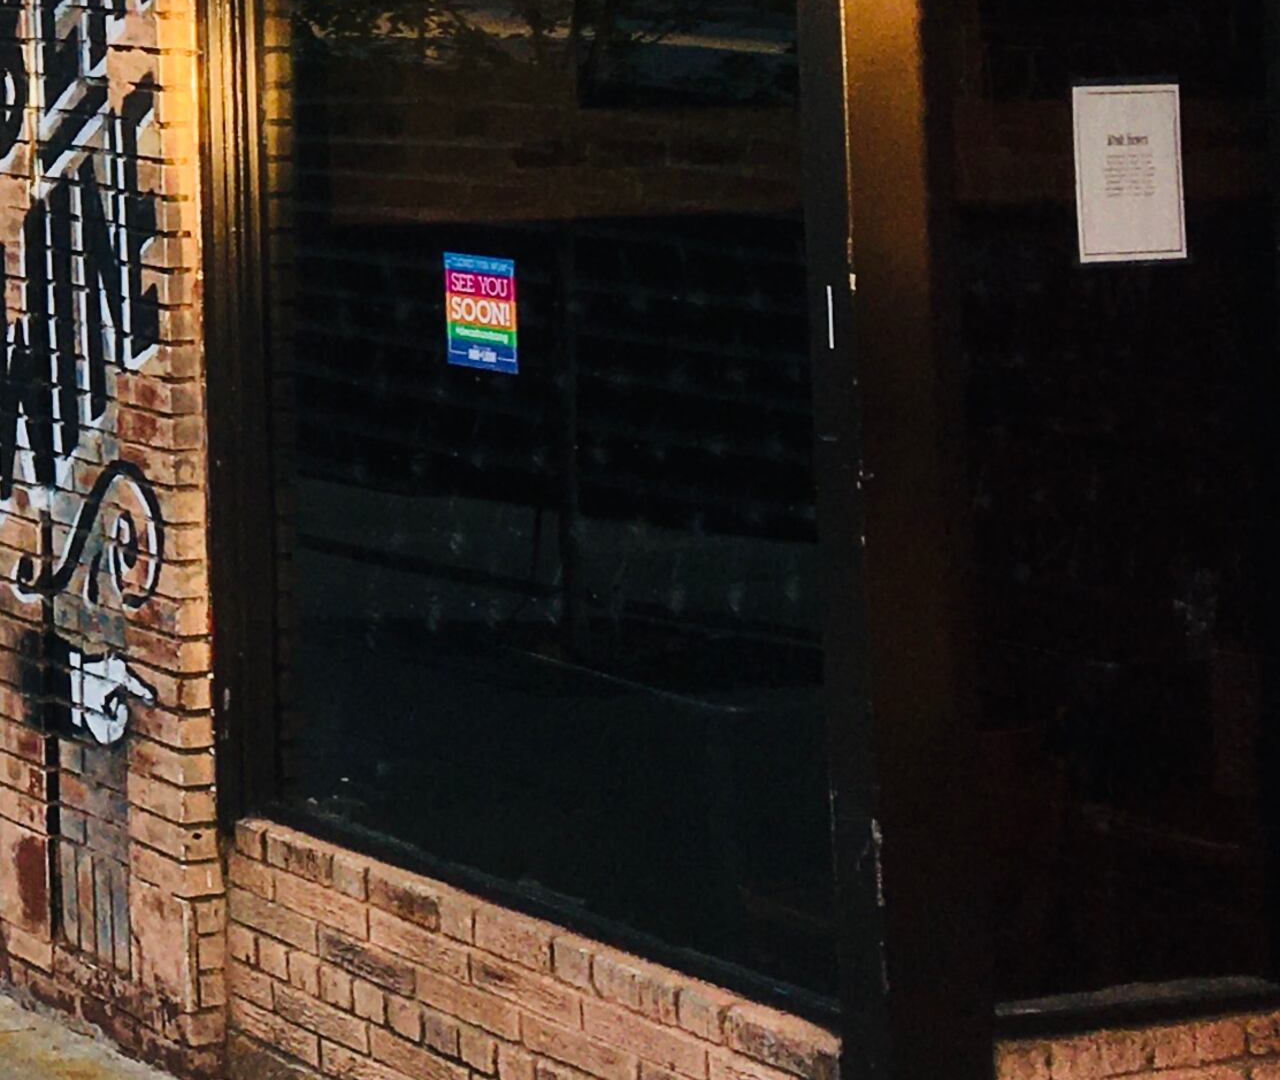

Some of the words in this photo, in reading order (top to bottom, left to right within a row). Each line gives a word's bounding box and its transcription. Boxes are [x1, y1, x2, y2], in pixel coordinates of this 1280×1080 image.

[450, 272, 476, 293] SEE
[477, 275, 508, 297] YOU
[450, 296, 511, 327] SOON!
